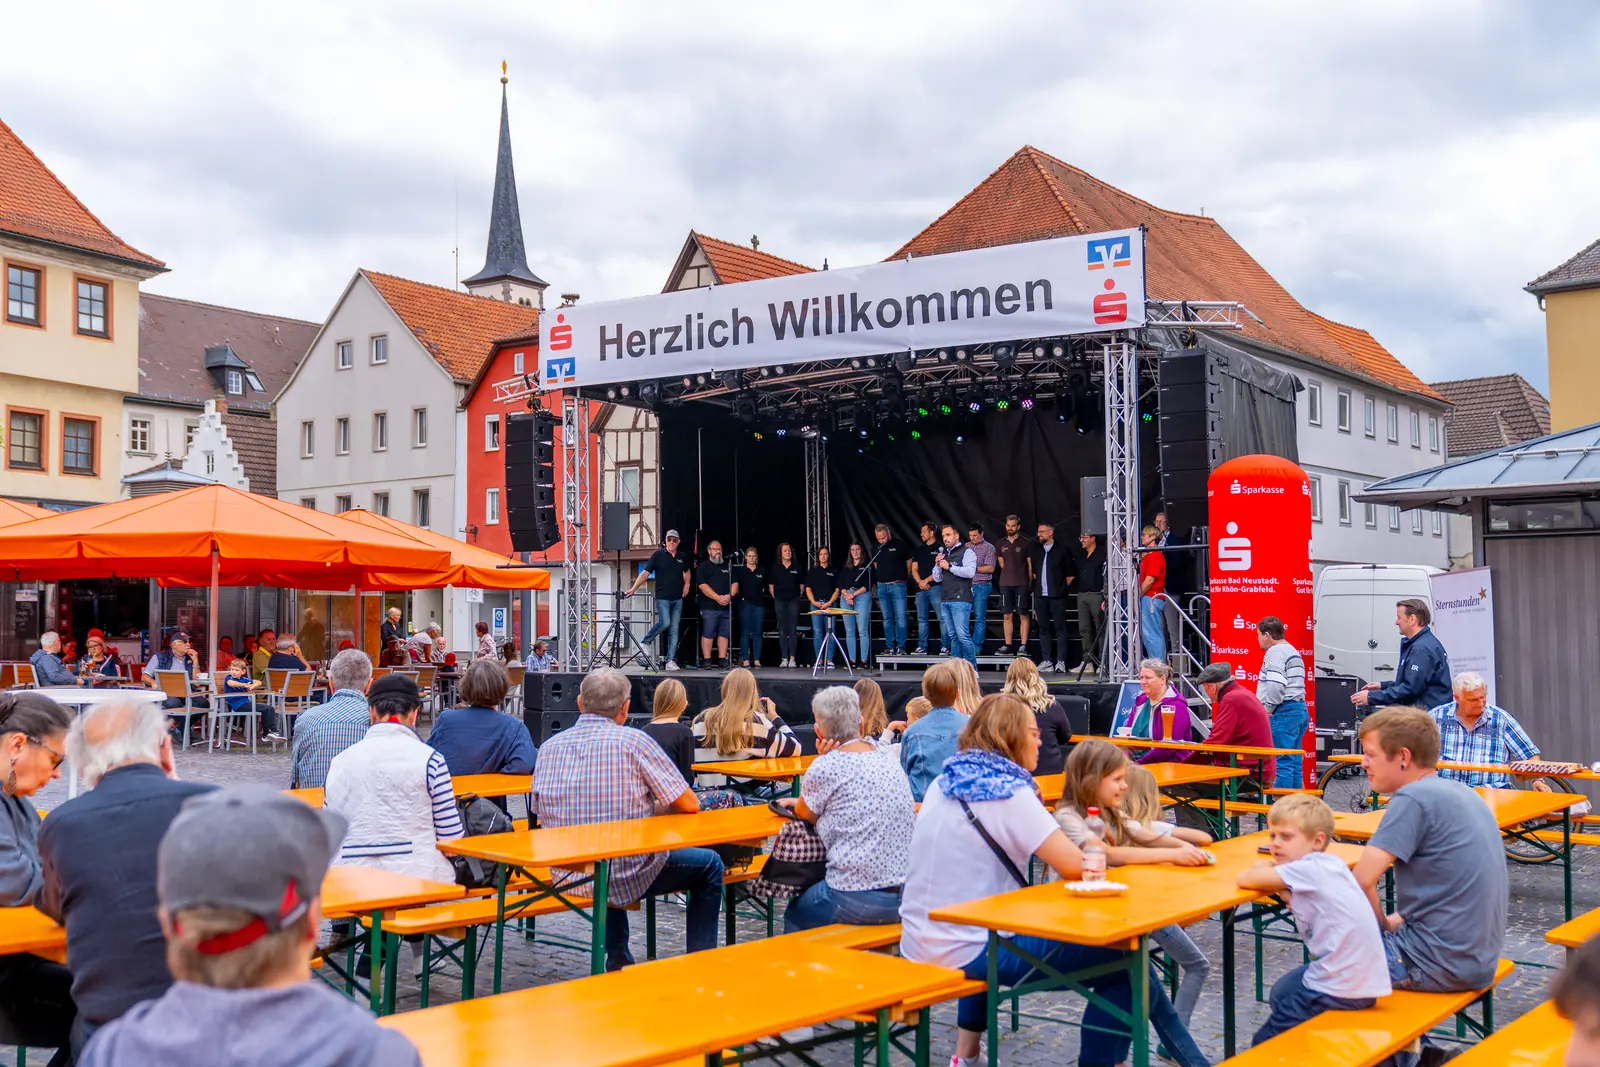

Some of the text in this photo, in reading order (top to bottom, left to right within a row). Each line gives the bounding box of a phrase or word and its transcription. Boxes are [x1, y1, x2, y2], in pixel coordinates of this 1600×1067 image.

[600, 278, 1053, 361] Herzlich Willkommen
[1242, 485, 1285, 495] Sparkasse
[1435, 596, 1480, 611] Sternstunden
[1216, 645, 1249, 655] Sparkasse
